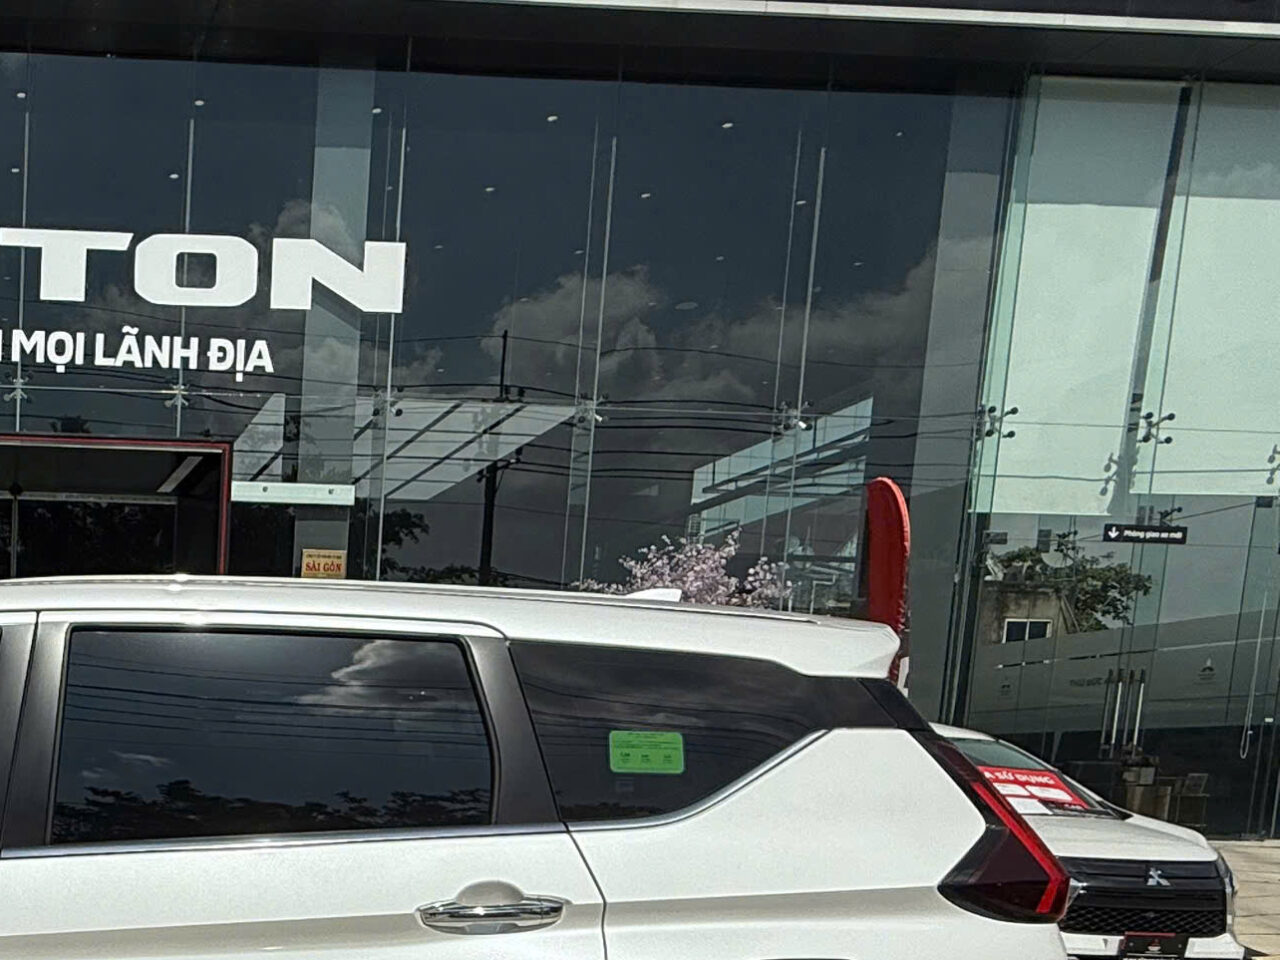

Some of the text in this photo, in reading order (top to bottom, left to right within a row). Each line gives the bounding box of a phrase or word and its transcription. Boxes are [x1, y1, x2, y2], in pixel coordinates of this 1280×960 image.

[11, 329, 85, 375] MỌI
[94, 325, 199, 370] LÃNH
[206, 338, 274, 383] ĐỊA
